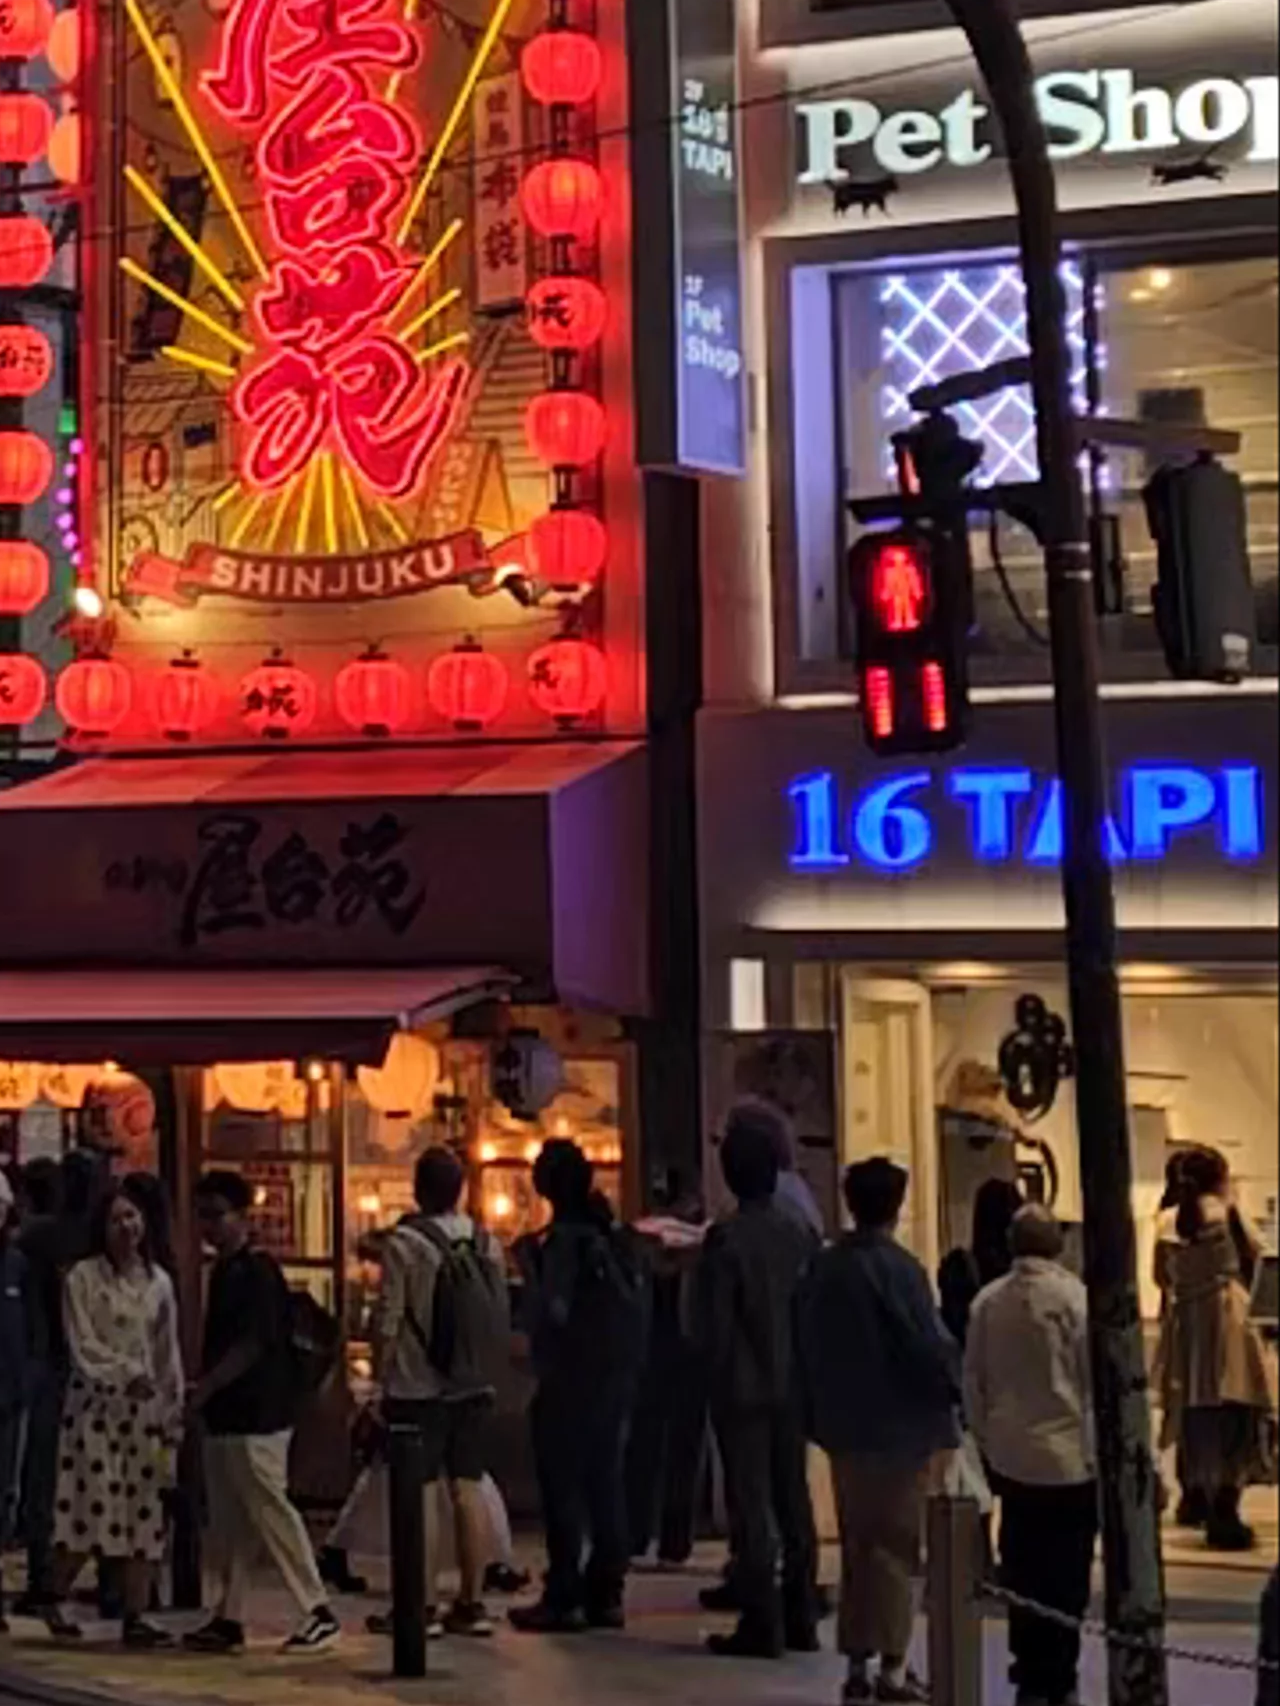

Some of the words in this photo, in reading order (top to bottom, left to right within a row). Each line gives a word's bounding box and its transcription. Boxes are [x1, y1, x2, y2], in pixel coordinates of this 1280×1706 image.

[796, 96, 991, 184] Pet
[209, 542, 458, 598] SHINJUKU
[790, 770, 932, 870] 16
